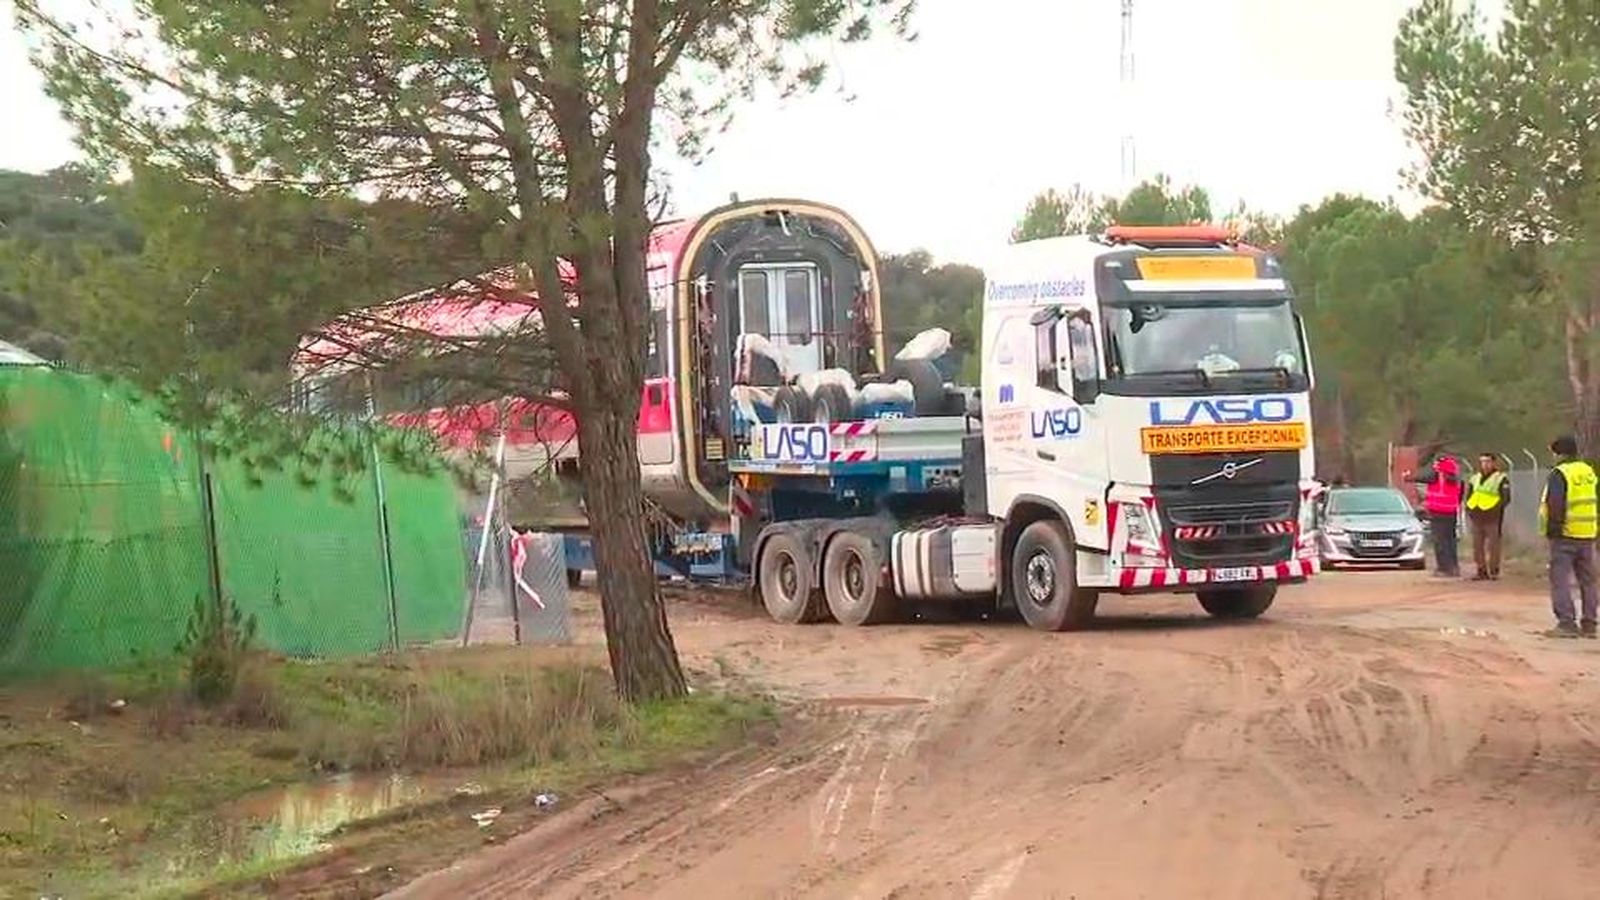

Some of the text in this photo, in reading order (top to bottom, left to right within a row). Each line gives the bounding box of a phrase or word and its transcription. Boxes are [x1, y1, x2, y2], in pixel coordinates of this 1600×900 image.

[988, 275, 1086, 303] Overcoming obstacles
[1031, 406, 1081, 438] LASO
[1150, 397, 1293, 425] LASO
[763, 426, 828, 460] LASO
[1148, 431, 1224, 448] TRANSPORTE
